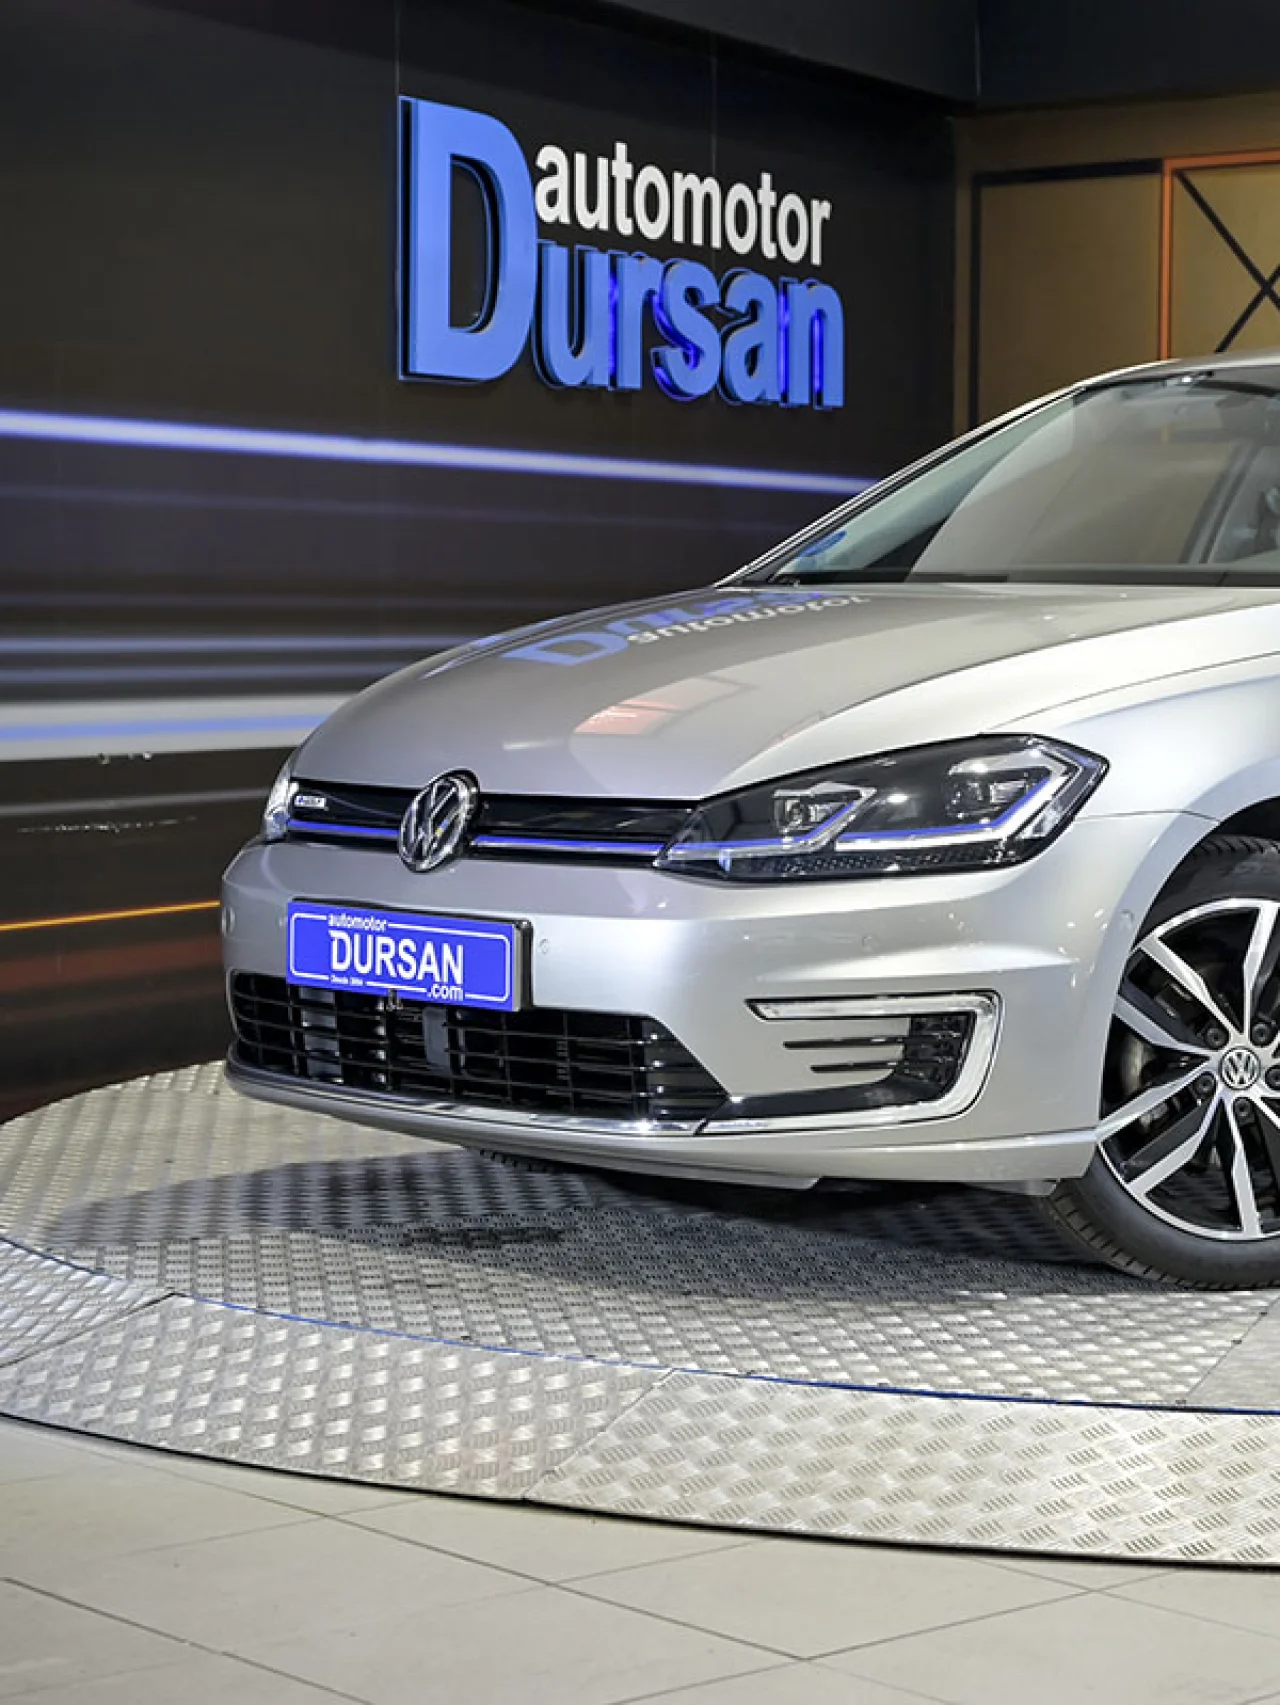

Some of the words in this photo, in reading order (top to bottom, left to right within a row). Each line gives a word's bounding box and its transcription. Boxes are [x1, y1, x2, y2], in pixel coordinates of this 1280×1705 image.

[535, 142, 832, 266] automotor
[399, 95, 845, 410] Dursan
[328, 929, 464, 985] DURSAN
[427, 983, 464, 1001] .com
